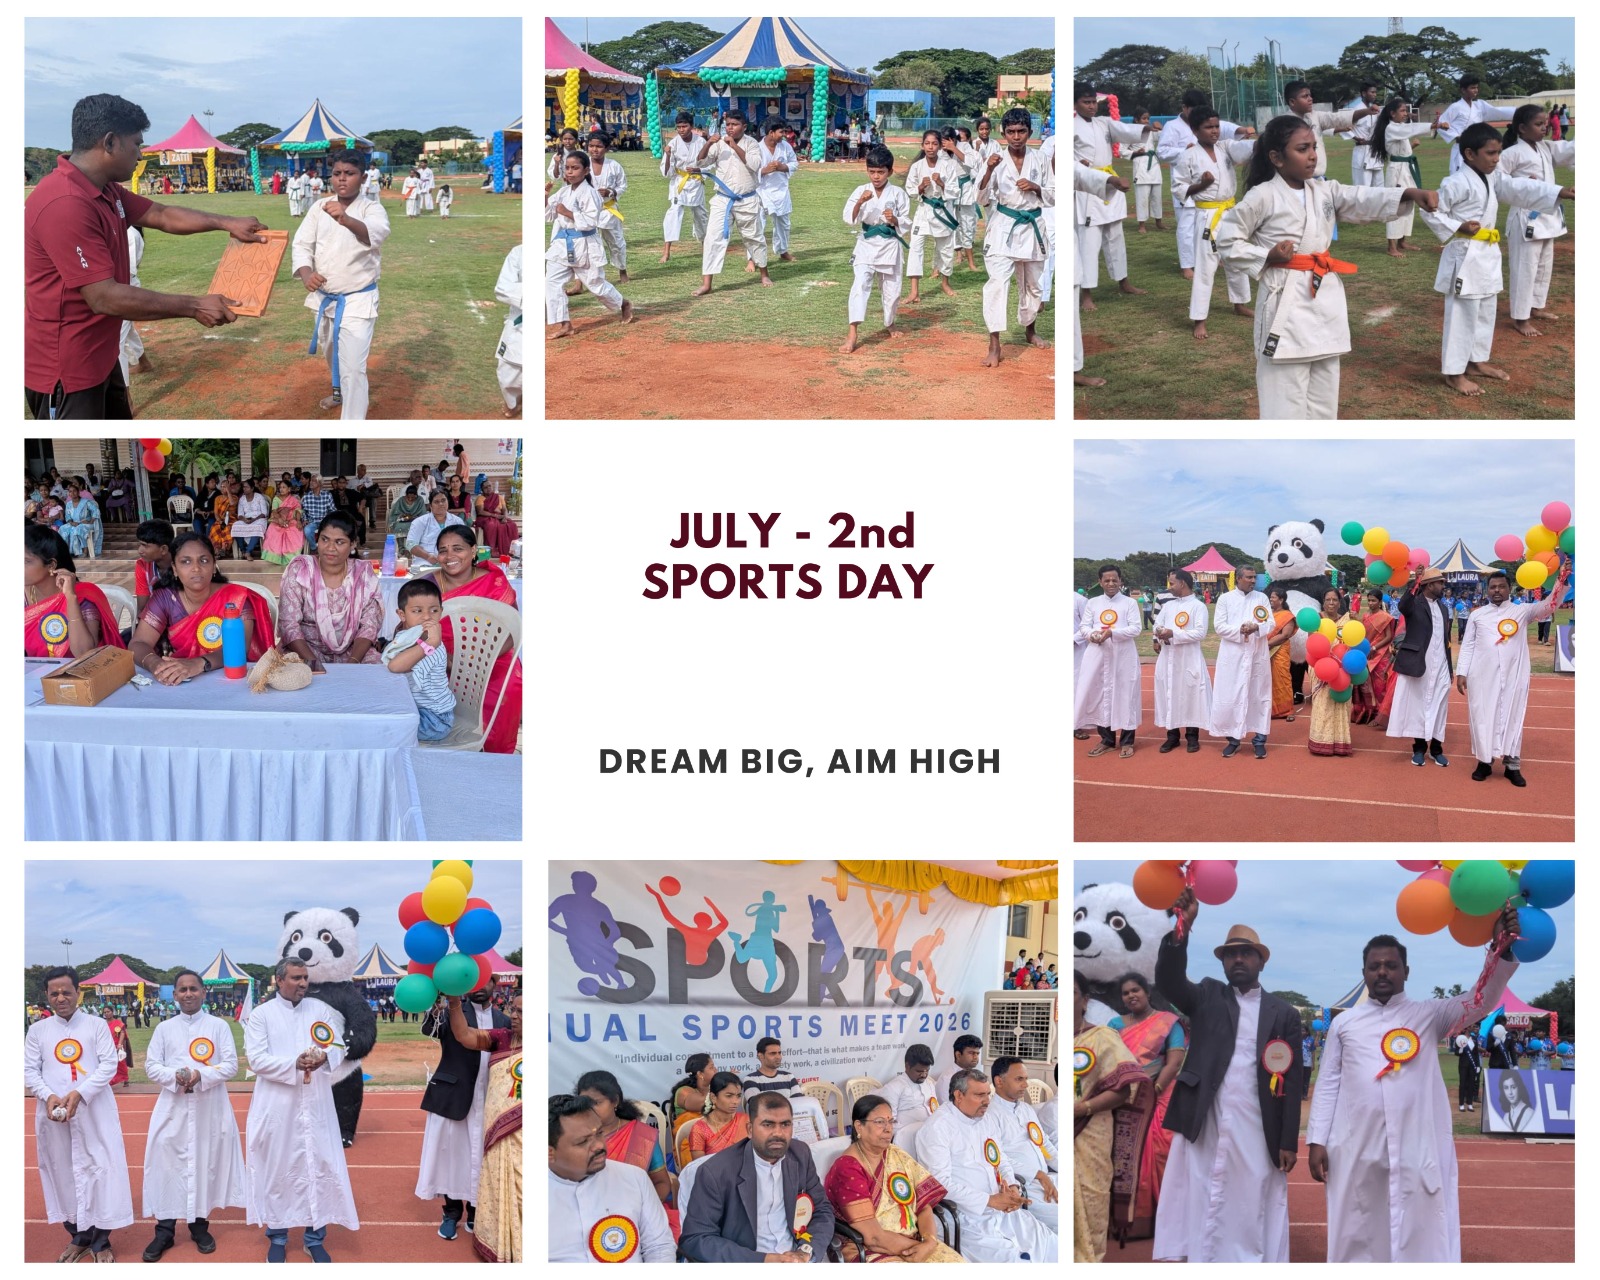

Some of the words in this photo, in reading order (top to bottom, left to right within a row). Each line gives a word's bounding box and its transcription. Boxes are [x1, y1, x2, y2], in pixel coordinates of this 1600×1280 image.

[172, 153, 190, 162] ZATTI
[1457, 573, 1479, 581] LAURA
[596, 921, 924, 1007] SPORTS
[376, 978, 397, 986] LAURA
[682, 1014, 823, 1041] SPORTS
[840, 1014, 907, 1037] MEET
[919, 1012, 971, 1033] 2026
[737, 1050, 747, 1059] to
[831, 1045, 848, 1053] what
[849, 1045, 870, 1053] makes
